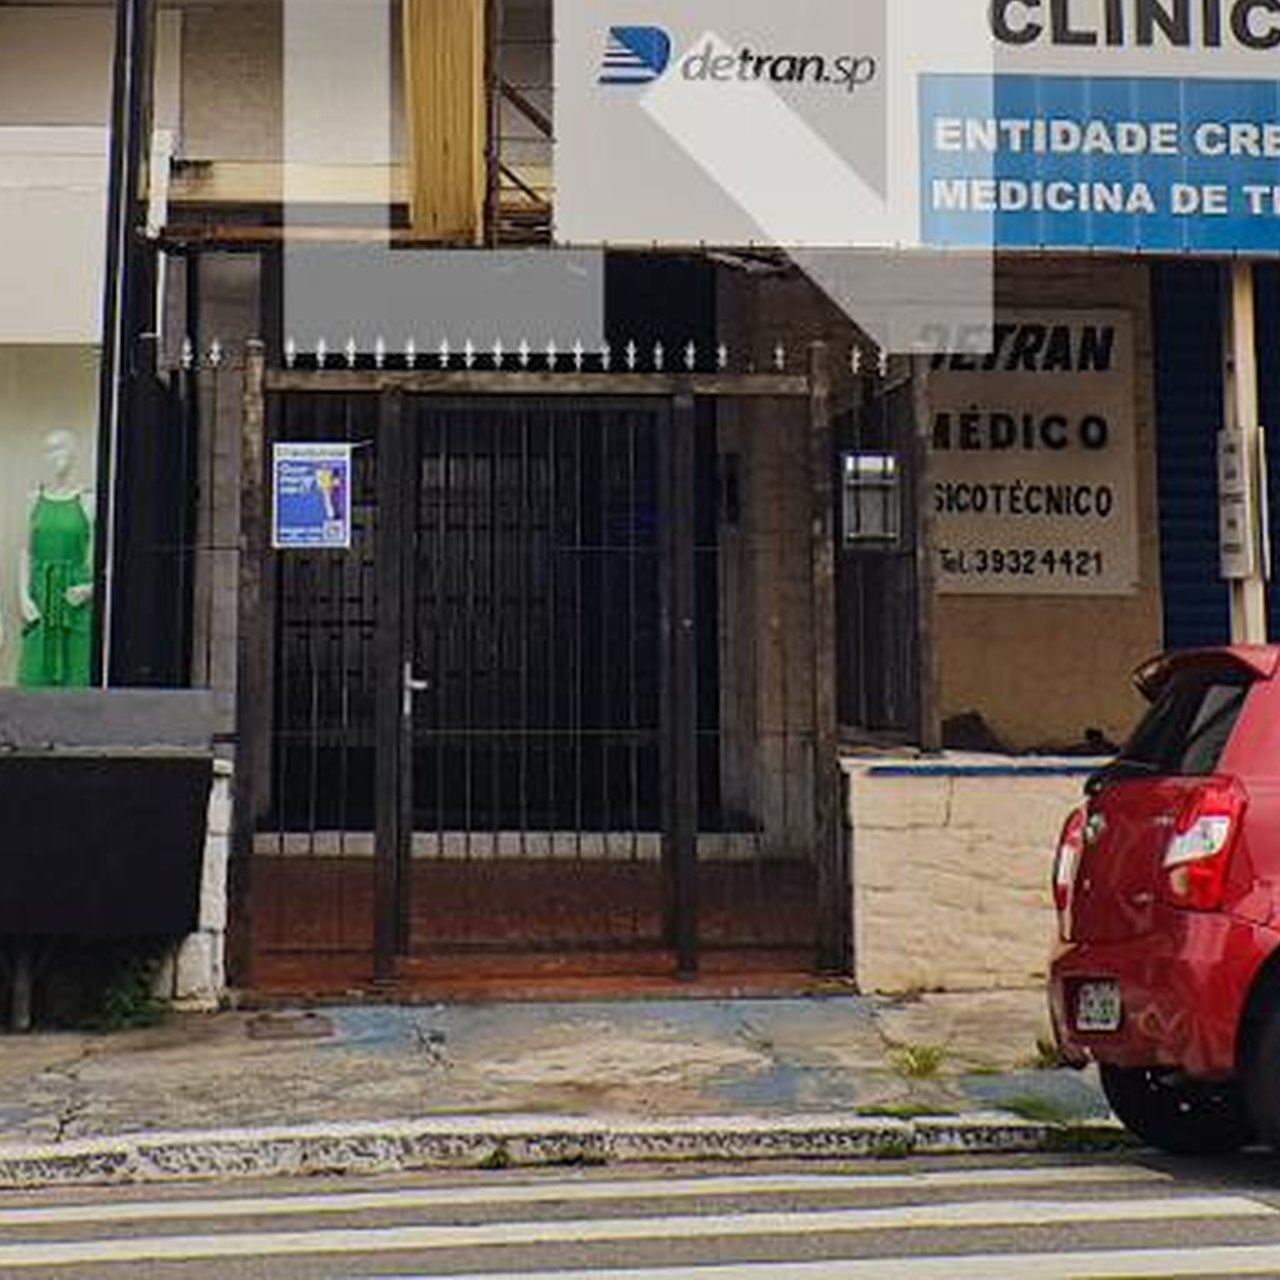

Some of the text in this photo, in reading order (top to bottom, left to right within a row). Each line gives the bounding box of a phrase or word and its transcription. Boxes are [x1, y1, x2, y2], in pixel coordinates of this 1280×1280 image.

[681, 40, 877, 93] detran.sp
[934, 118, 1177, 156] ENTIDADE
[932, 179, 1155, 214] MEDICINA
[1171, 185, 1229, 216] DE
[934, 480, 1113, 518] SICOTÉCNICO
